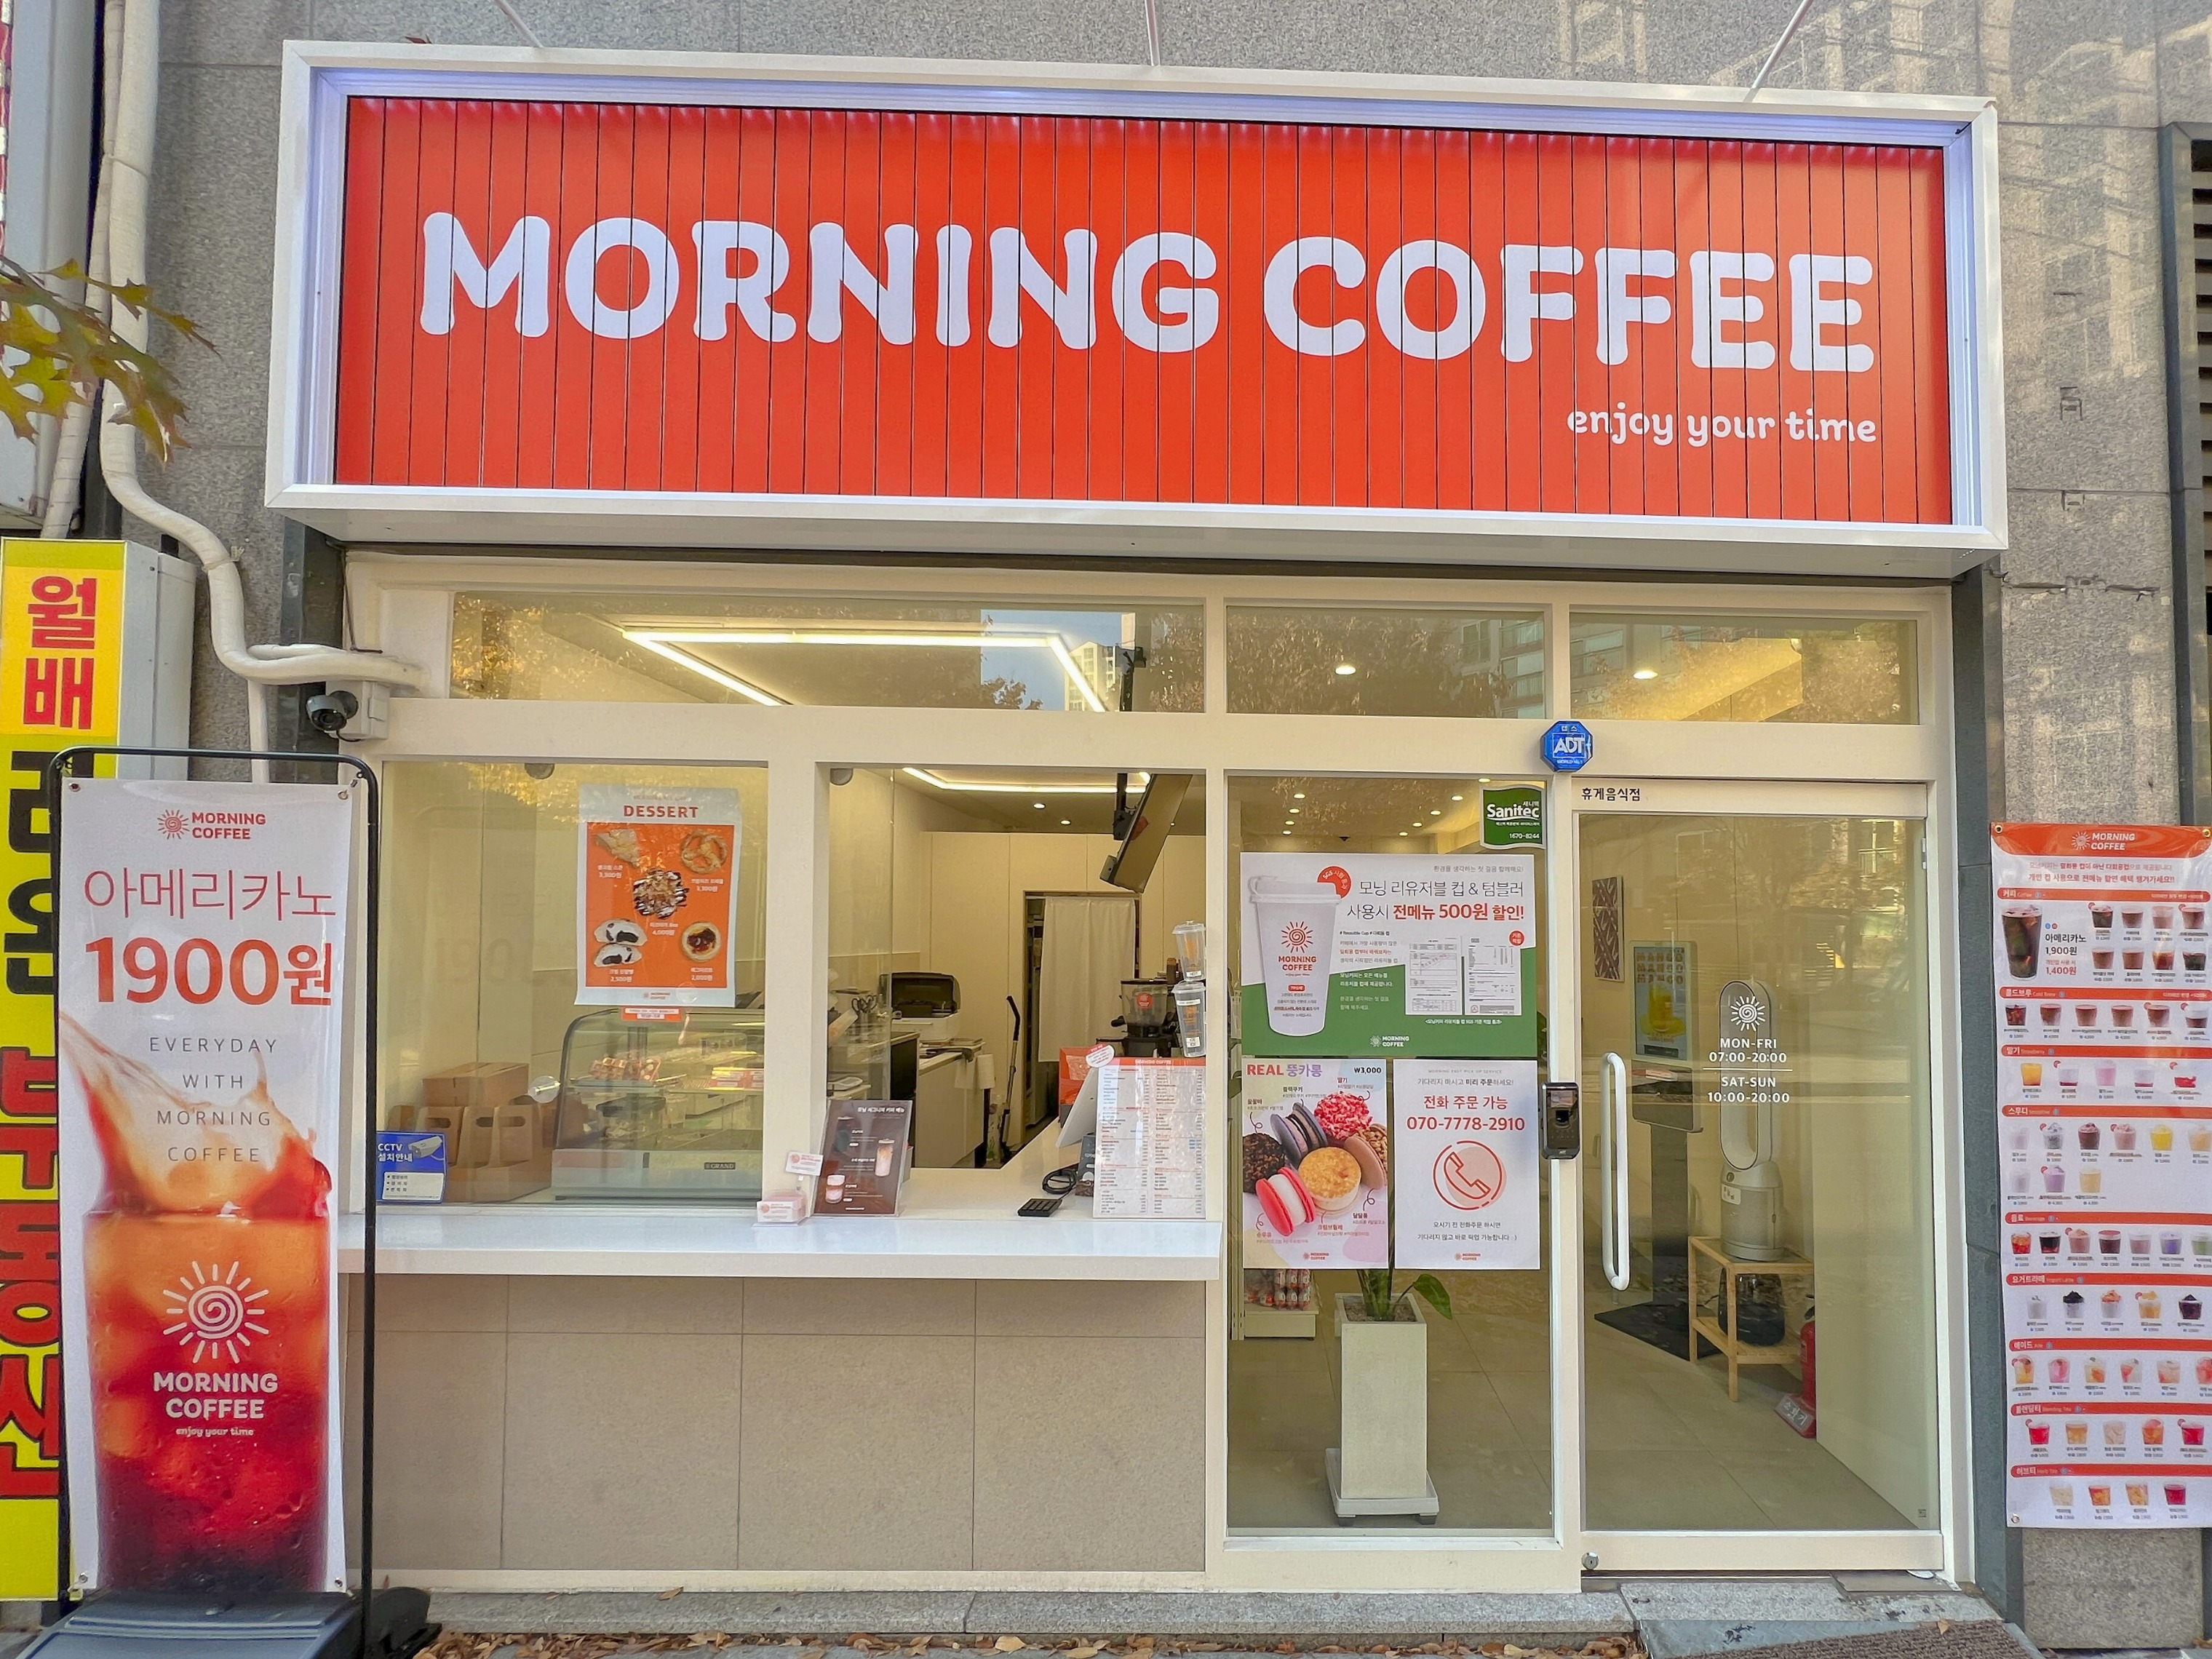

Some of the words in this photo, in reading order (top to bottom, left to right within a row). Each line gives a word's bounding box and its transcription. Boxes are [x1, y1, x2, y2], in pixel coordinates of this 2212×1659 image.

[420, 211, 1220, 353] MORNING
[1263, 236, 1874, 372] COFFEE
[1567, 402, 1674, 447] enjoy
[1687, 411, 1775, 447] your
[1785, 408, 1877, 442] time
[23, 576, 97, 730] 월배
[1553, 736, 1585, 754] ADT
[1581, 788, 1641, 801] 휴게음식점
[624, 805, 699, 819] DESSERT
[1487, 803, 1540, 818] Sanitec
[192, 812, 266, 827] MORNING
[192, 827, 251, 840] COFFEE
[2092, 832, 2136, 841] MORNING
[2091, 843, 2125, 851] COFFEE
[2053, 874, 2080, 882] 사용으로
[2082, 875, 2102, 883] 전메뉴
[84, 867, 337, 920] 아메리카노
[1359, 881, 1387, 896] 모닝
[1391, 881, 1447, 896] 리유저블
[1451, 881, 1465, 896] 컵
[1468, 883, 1479, 896] &
[1482, 881, 1524, 896] 텀블러
[2002, 889, 2016, 897] 커피
[1347, 904, 1388, 920] 사용시
[1393, 904, 1436, 920] 전메뉴
[1439, 903, 1489, 920] 500원
[1492, 904, 1524, 920] 할인!
[2045, 934, 2088, 943] 아메리카노
[2045, 946, 2077, 955] 1,900원
[1637, 952, 1684, 963] MANGO
[85, 936, 333, 1006] 1900원
[1637, 963, 1683, 973] MANGO
[2045, 966, 2077, 975] 1,400원
[2005, 989, 2032, 997] 콜드브루
[149, 1038, 277, 1054] EVERYDAY
[1720, 1038, 1778, 1049] MON-FRI
[1708, 1051, 1788, 1063] 07:00-20:00
[2007, 1046, 2020, 1055] 딸기
[1246, 1064, 1284, 1075] REAL
[1286, 1064, 1322, 1078] 뚱카롱
[1353, 1067, 1382, 1075] ₩3,000
[183, 1073, 244, 1089] WITH
[1722, 1076, 1777, 1087] SAT-SUN
[1424, 1095, 1449, 1110] 전화
[1453, 1096, 1479, 1110] 주문
[1483, 1096, 1508, 1110] 가능
[1708, 1092, 1790, 1103] 10:00-20:00
[2008, 1107, 2028, 1115] 스무디
[156, 1110, 272, 1126] MORNING
[1407, 1116, 1526, 1131] 070-7778-2910
[378, 1143, 403, 1152] CCTV
[168, 1146, 260, 1163] COFFEE
[377, 1153, 413, 1163] 설치안내
[2012, 1275, 2045, 1283] 요거트라떼
[2013, 1341, 2033, 1349] 에이드
[153, 1372, 278, 1394] MORNING
[166, 1397, 265, 1420] COFFEE
[1783, 1401, 1808, 1426] 소화기
[175, 1426, 203, 1438] enjoy
[204, 1428, 228, 1438] your
[230, 1426, 254, 1436] time
